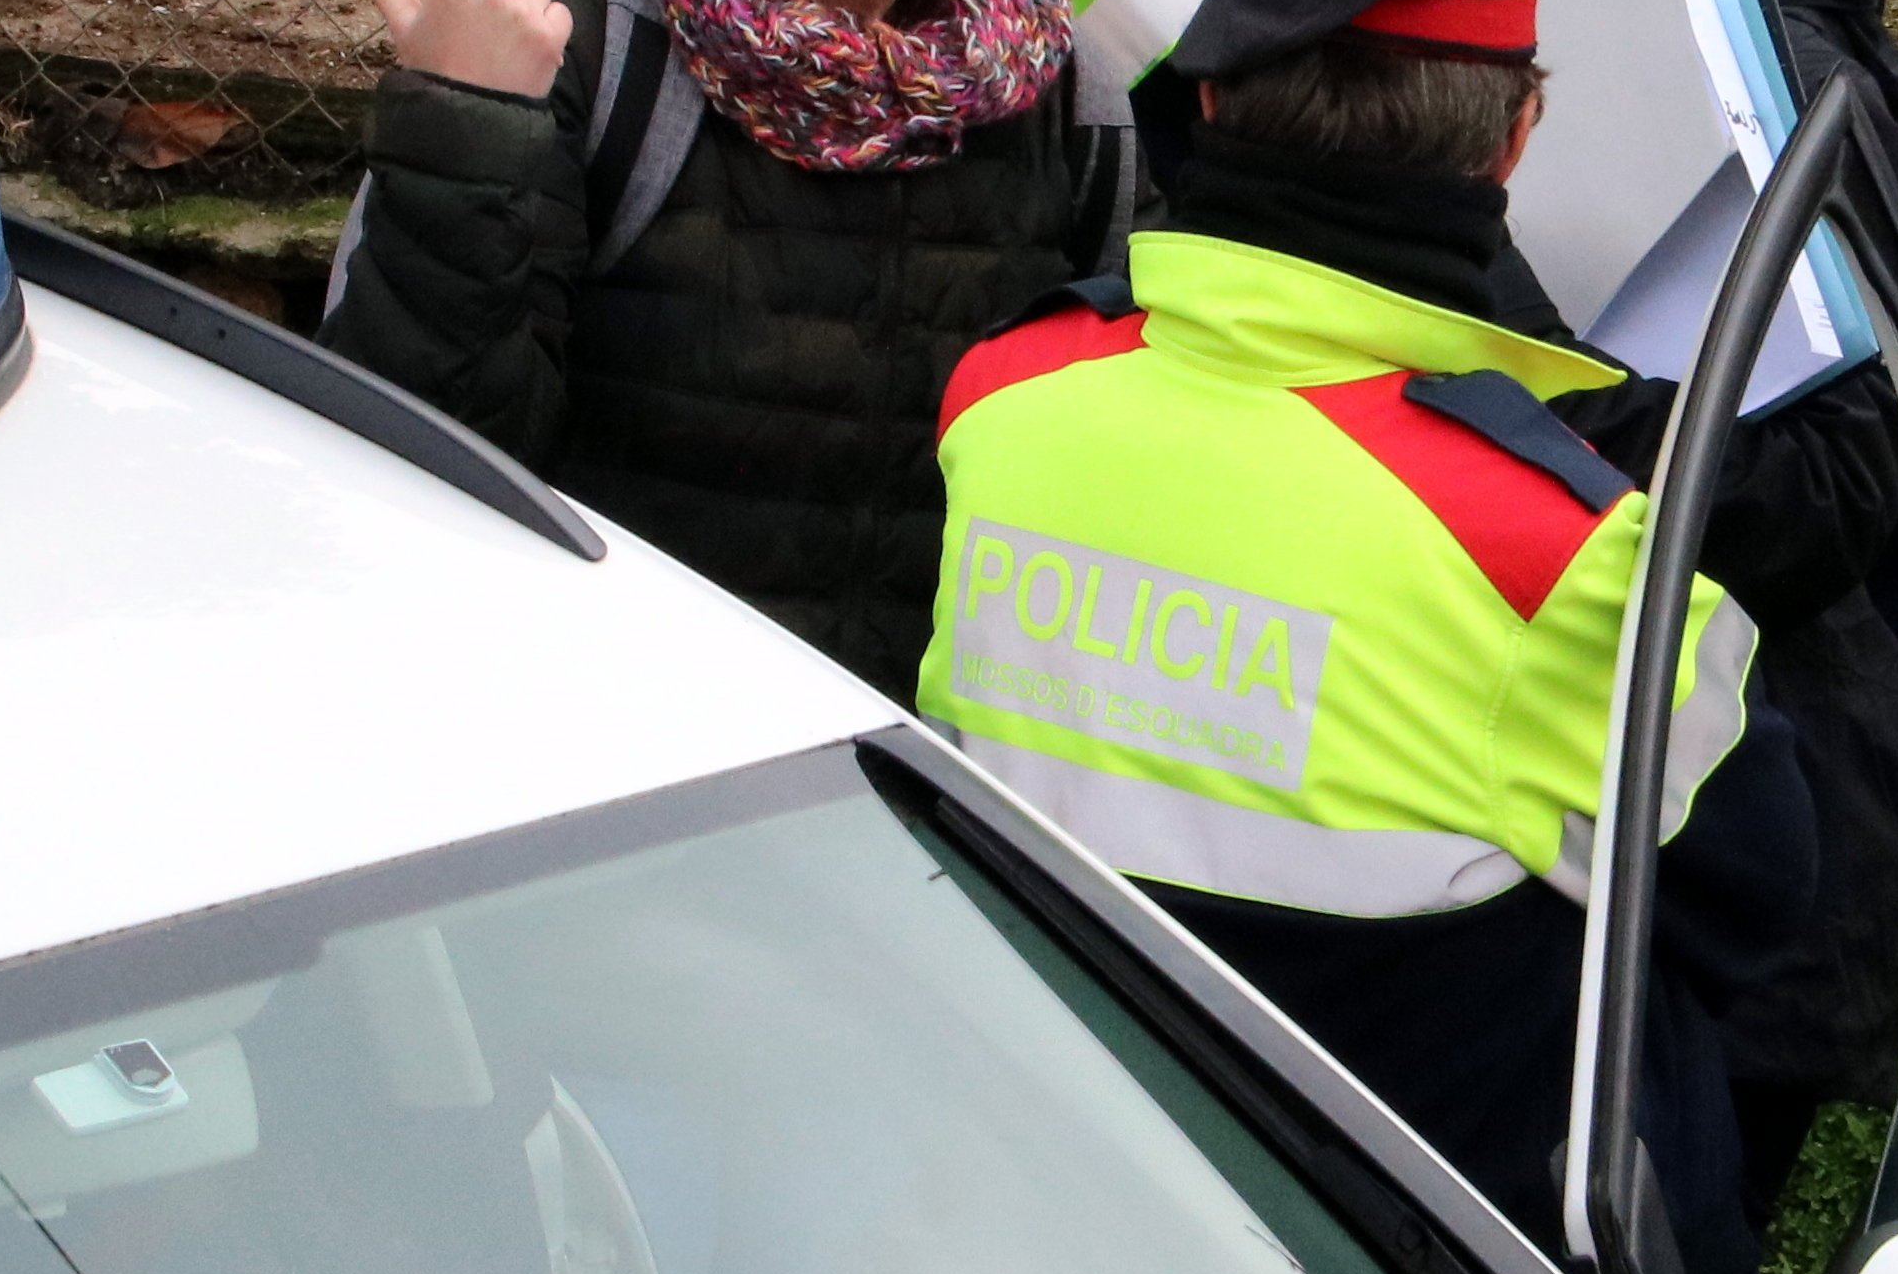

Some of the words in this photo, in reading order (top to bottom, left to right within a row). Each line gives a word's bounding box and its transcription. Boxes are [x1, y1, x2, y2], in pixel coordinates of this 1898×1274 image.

[964, 534, 1295, 711] POLICIA
[962, 650, 1069, 710] MOSSOS
[1076, 683, 1286, 772] D'ESQUADRA
